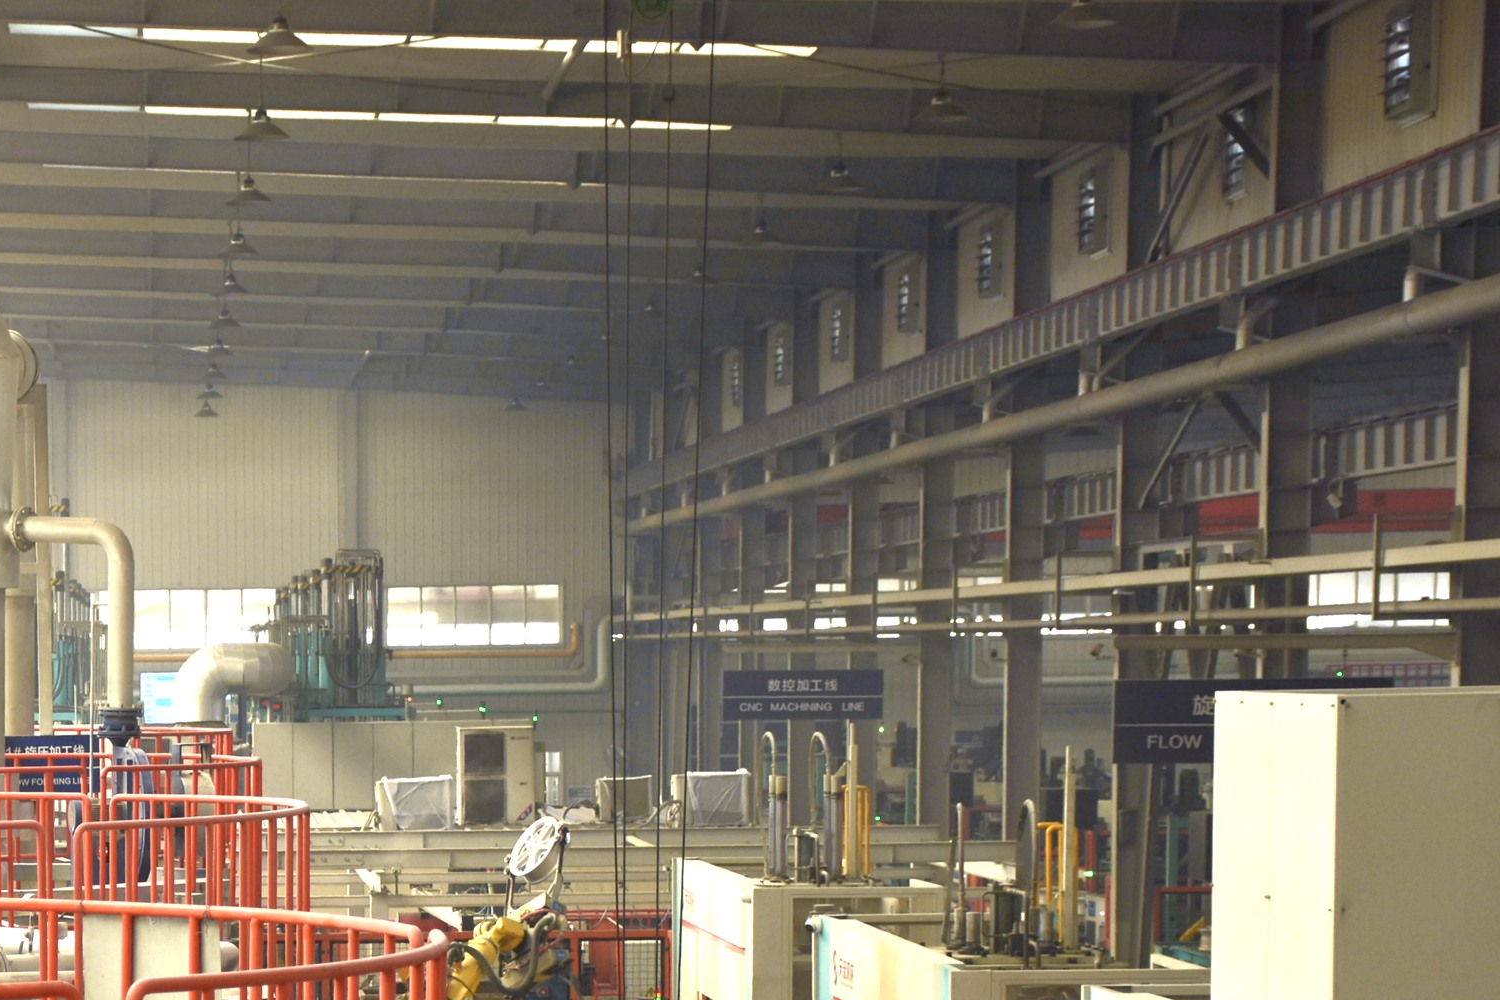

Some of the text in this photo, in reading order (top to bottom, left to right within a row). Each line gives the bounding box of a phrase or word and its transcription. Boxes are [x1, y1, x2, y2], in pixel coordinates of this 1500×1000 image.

[767, 679, 839, 692] 数控加工线
[739, 702, 865, 712] CNC MACHINING LINE
[1146, 734, 1203, 749] FLOW
[31, 777, 71, 786] FOMING
